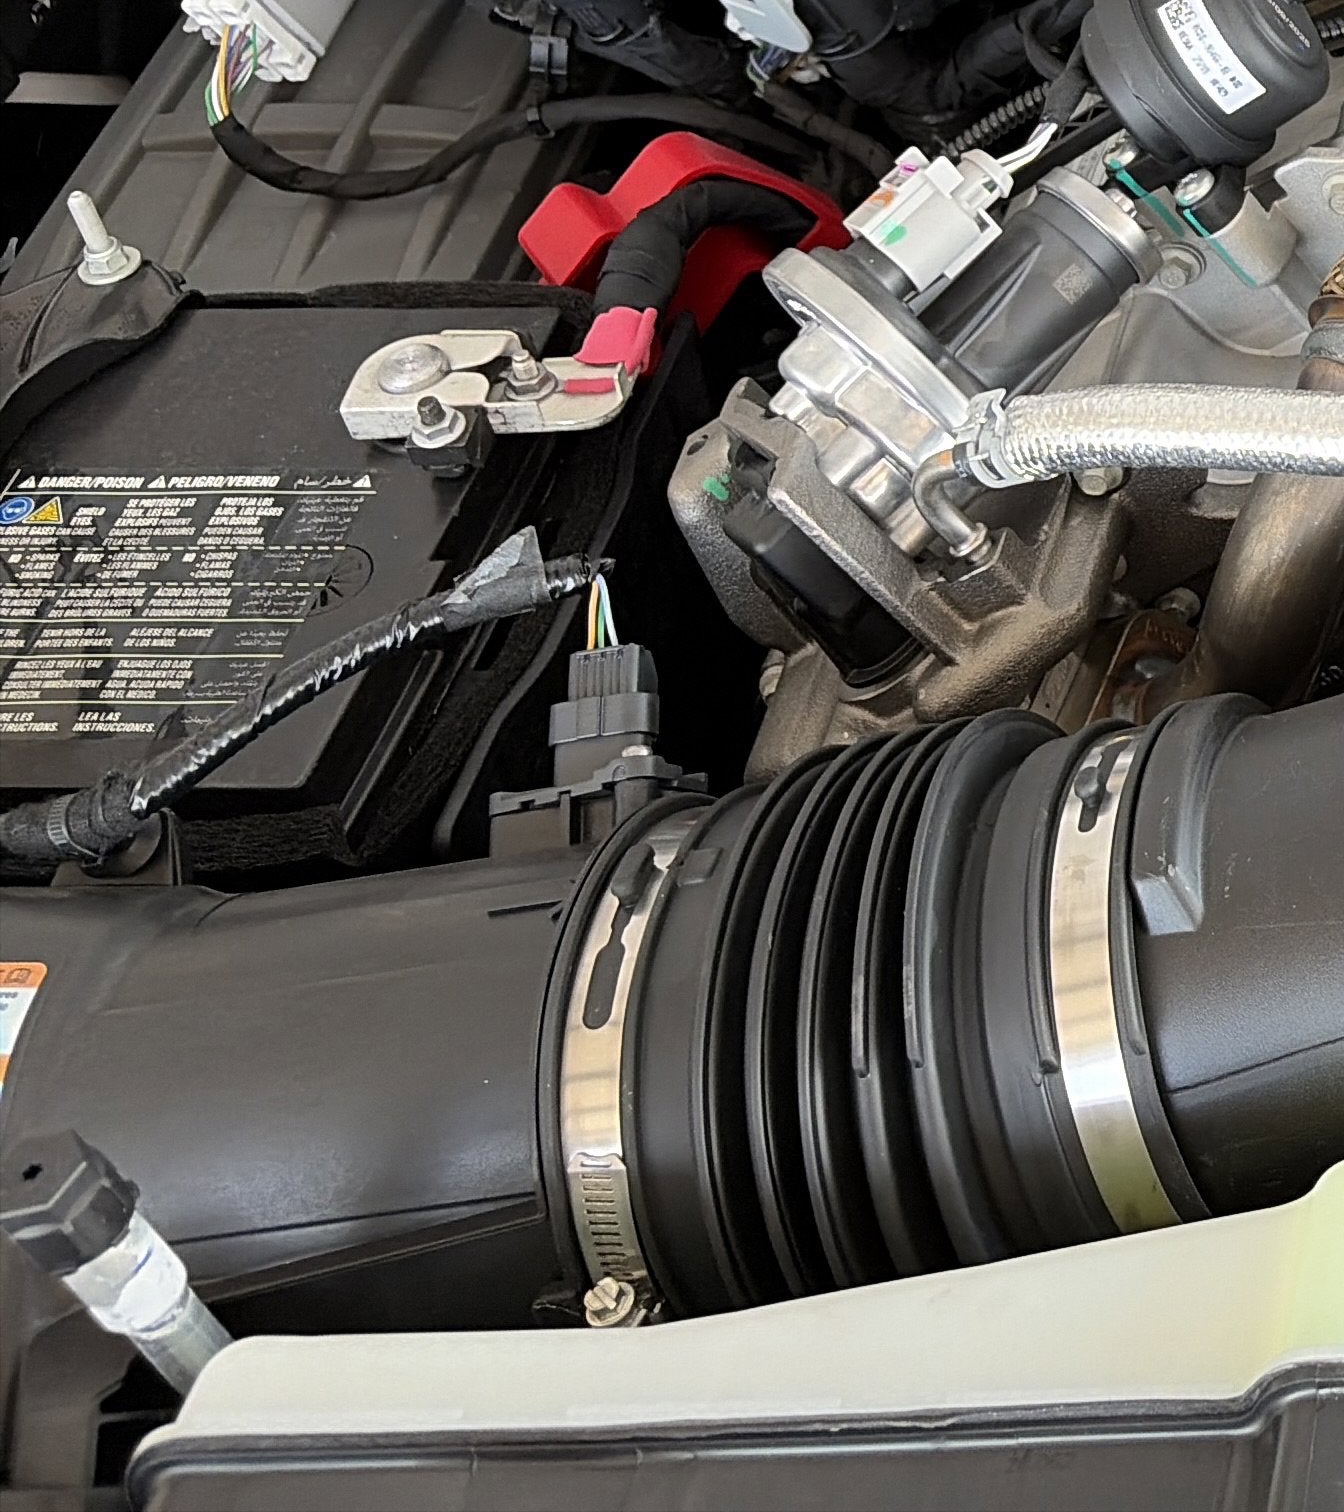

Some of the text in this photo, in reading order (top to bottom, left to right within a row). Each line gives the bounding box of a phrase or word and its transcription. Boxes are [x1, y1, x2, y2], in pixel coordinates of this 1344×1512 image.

[38, 476, 144, 488] DANGER/POISON
[168, 475, 280, 488] PELIGRO/VENENO
[180, 498, 197, 507] LES
[79, 712, 121, 721] LEA LAS
[72, 723, 155, 732] INSTRUCCIONES.
